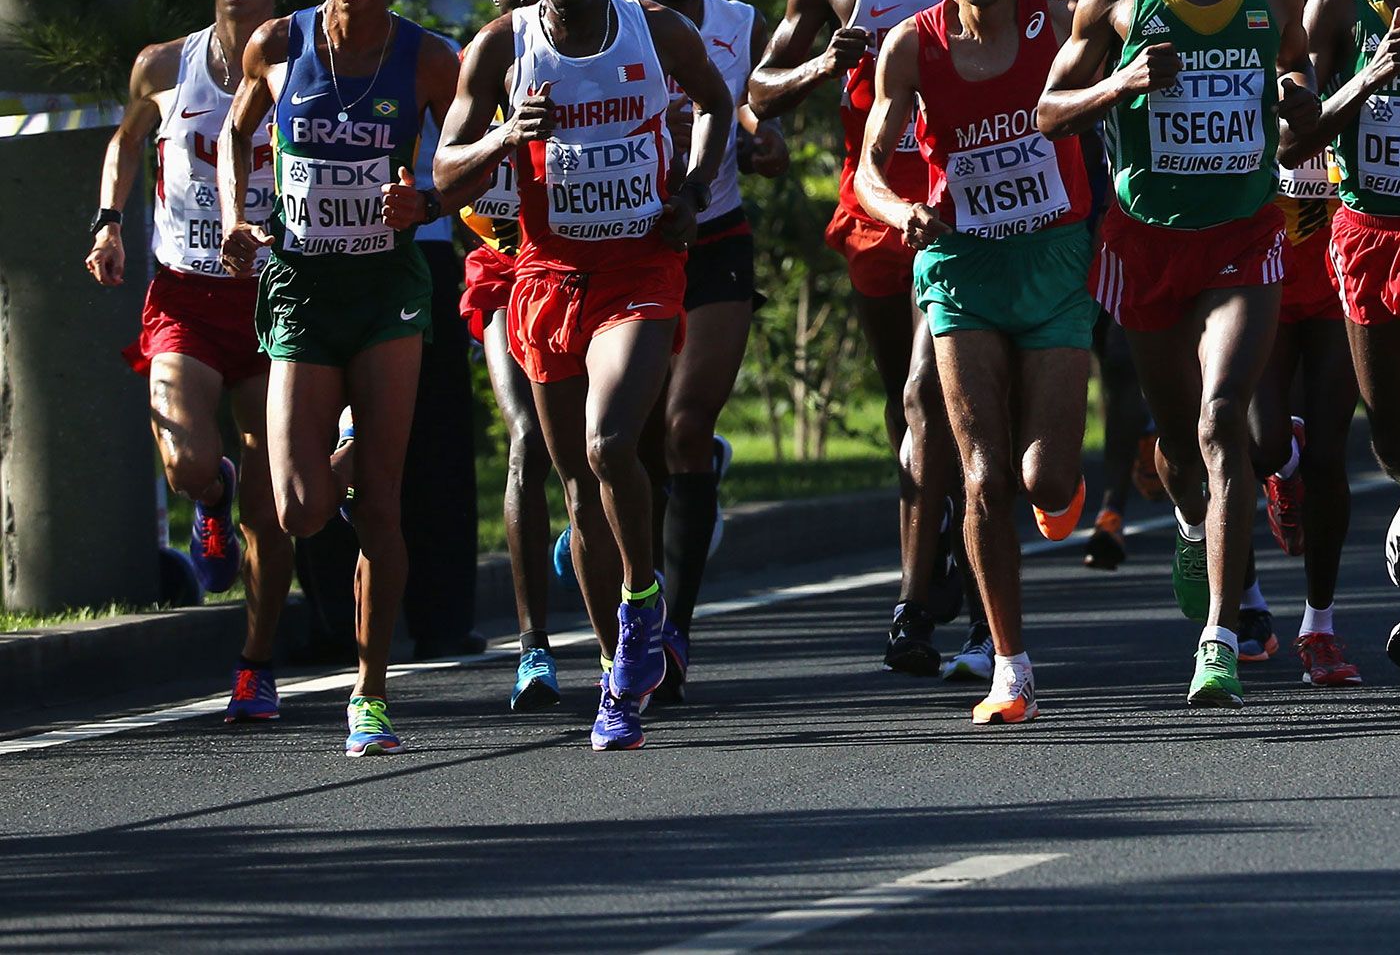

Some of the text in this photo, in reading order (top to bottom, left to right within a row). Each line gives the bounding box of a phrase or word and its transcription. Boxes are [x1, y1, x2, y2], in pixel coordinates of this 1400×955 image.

[1141, 25, 1171, 36] adidas
[1177, 48, 1262, 71] HIOPIA
[1183, 72, 1255, 97] TDK
[552, 95, 644, 129] AHRAIN
[292, 116, 396, 149] BRASIL
[1155, 109, 1256, 144] TSEGAY
[580, 137, 650, 169] TDK
[971, 136, 1047, 172] TDK
[1157, 153, 1259, 172] BEIJING 2015
[308, 162, 381, 185] TDK
[1279, 179, 1328, 196] EIJING
[552, 173, 655, 215] DECHASA
[964, 170, 1050, 216] KISRI
[286, 194, 383, 228] DA SILVA
[350, 234, 388, 253] 2015
[558, 222, 624, 238] BEIJING
